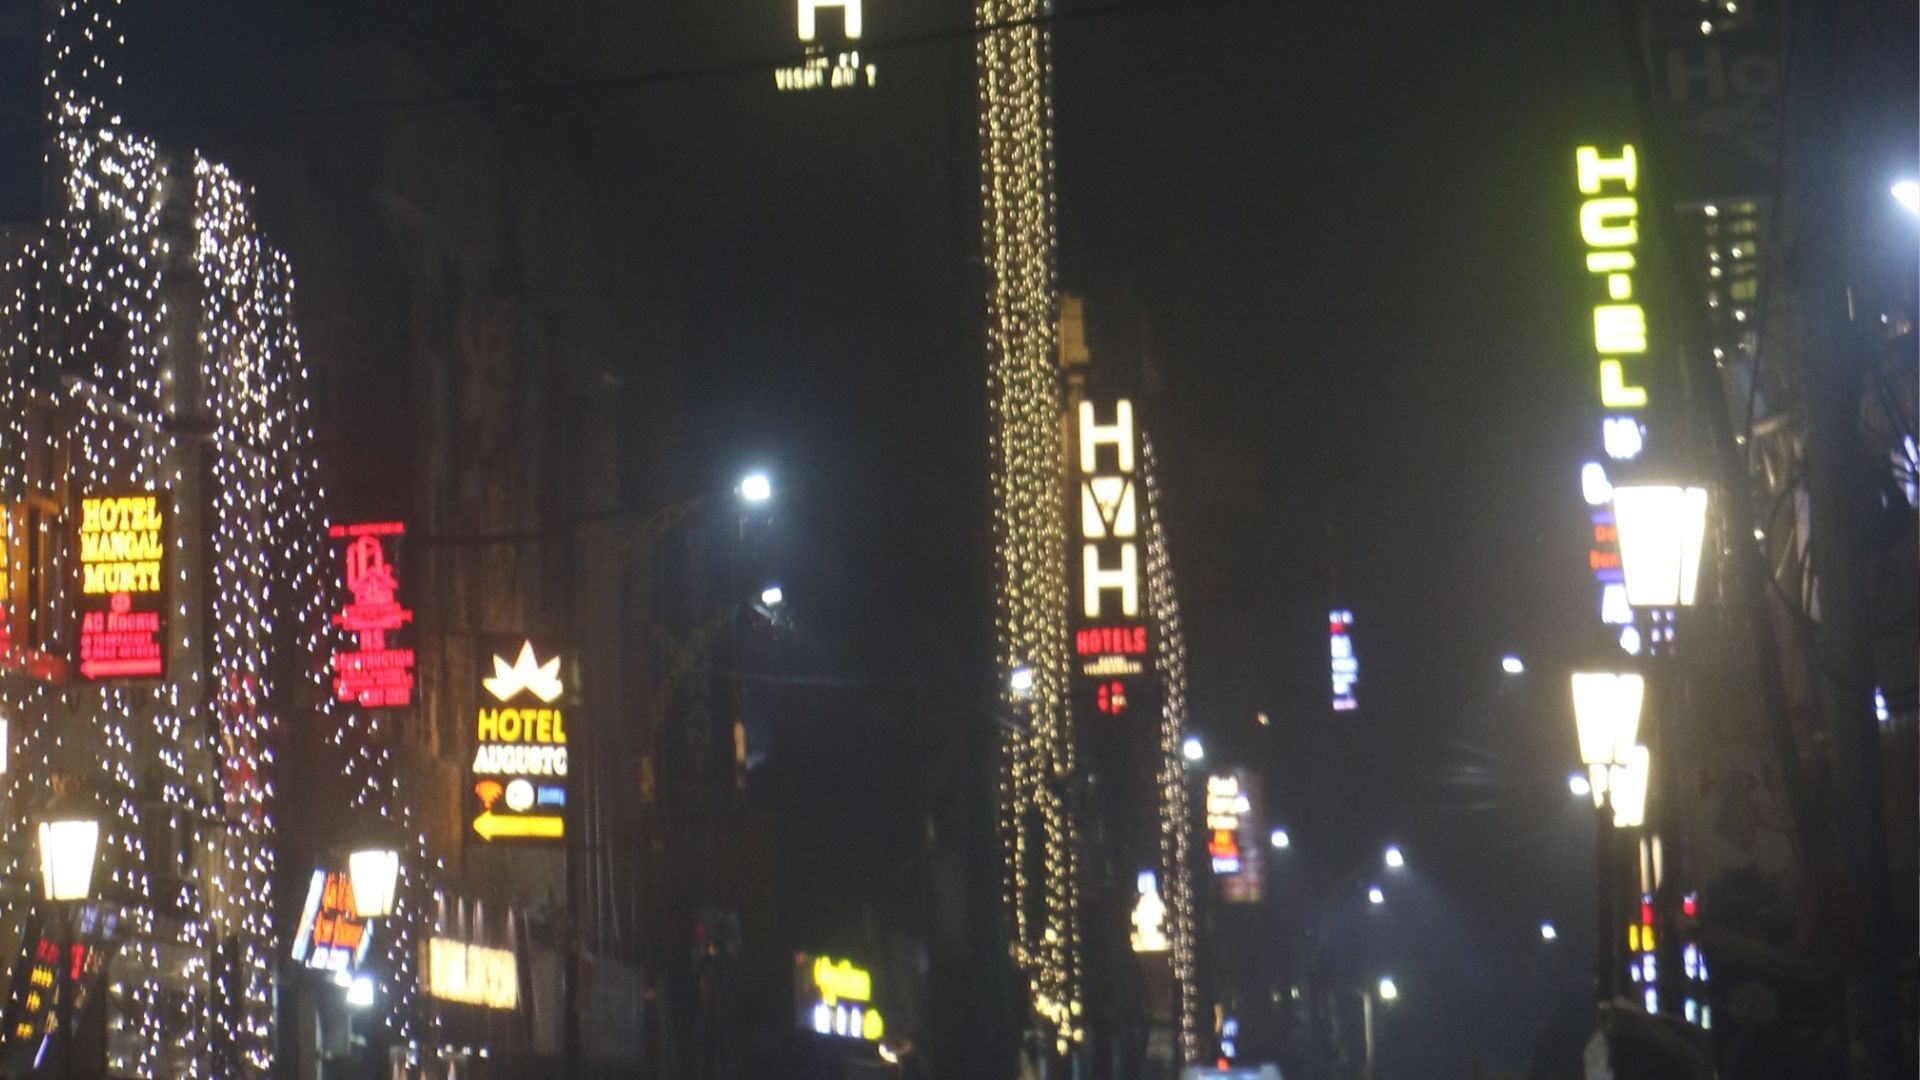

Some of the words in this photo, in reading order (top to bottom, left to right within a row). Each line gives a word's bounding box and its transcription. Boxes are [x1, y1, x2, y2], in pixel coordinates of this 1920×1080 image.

[82, 497, 162, 532] HOTEL
[81, 530, 163, 562] MANGAL
[83, 561, 160, 594] MURTI
[1076, 626, 1146, 655] HOTELS
[478, 707, 567, 743] HOTEL
